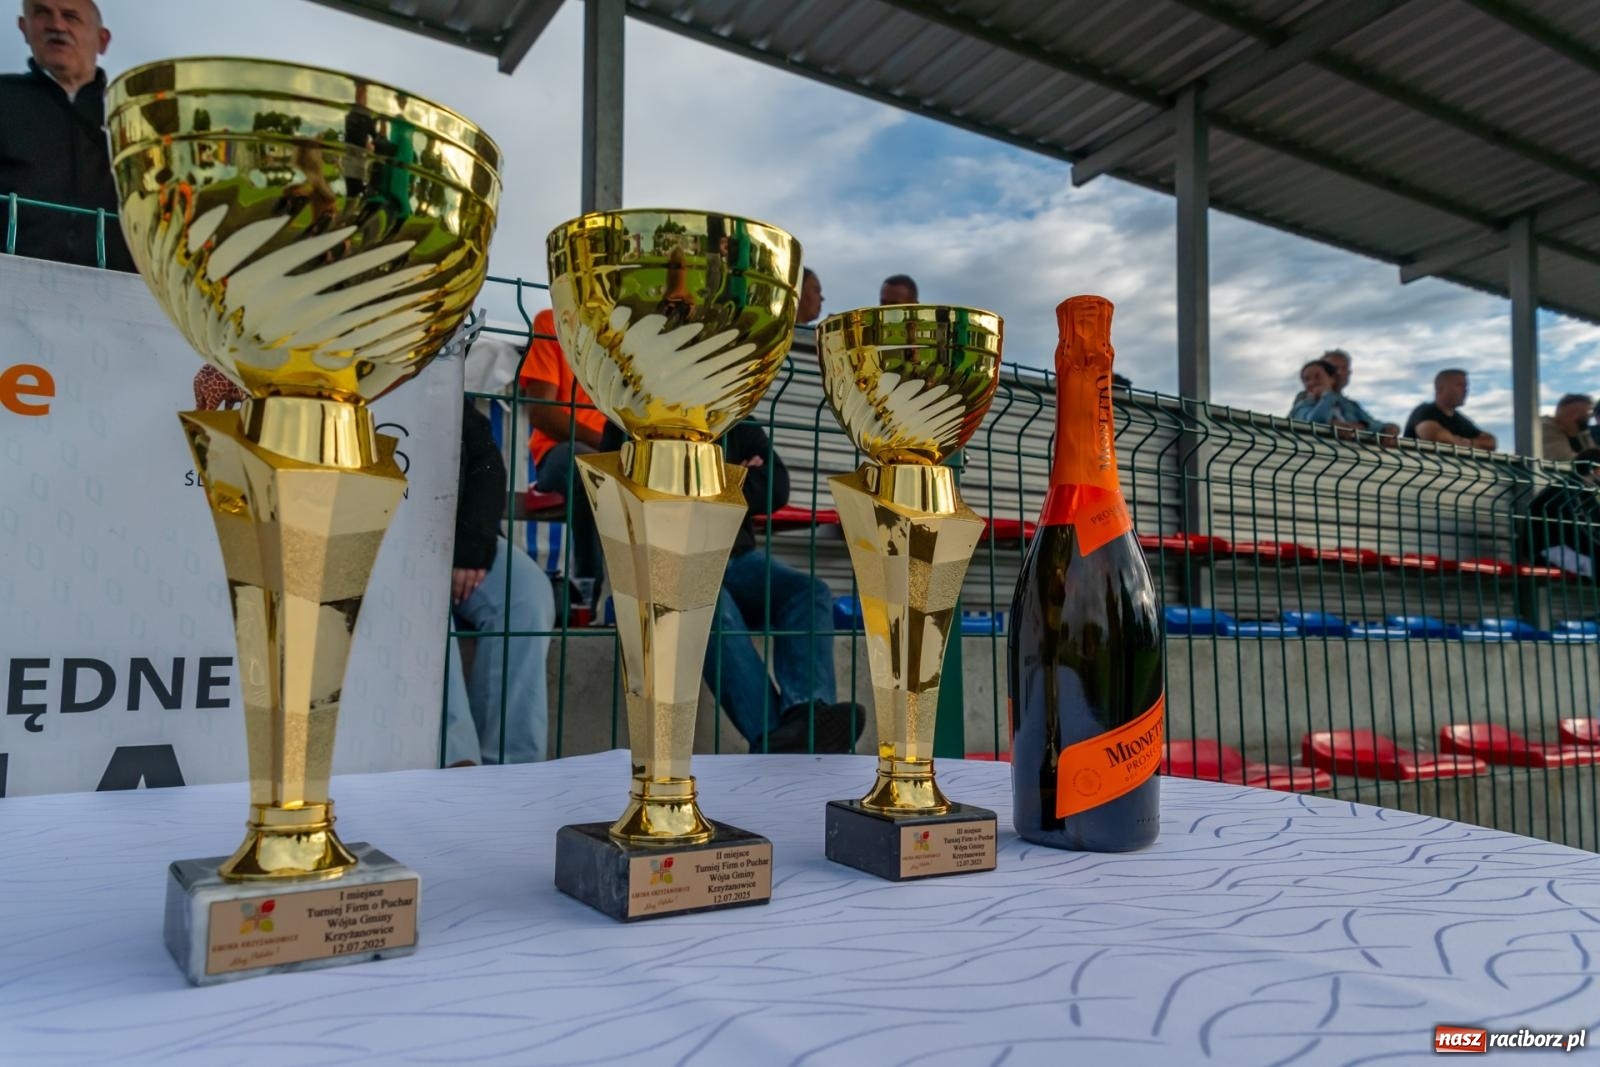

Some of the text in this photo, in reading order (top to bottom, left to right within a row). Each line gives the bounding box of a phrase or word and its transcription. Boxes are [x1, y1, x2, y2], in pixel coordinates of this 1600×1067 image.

[695, 864, 720, 873] Turniej
[722, 861, 738, 870] Firm
[746, 858, 769, 867] Puchar
[709, 871, 755, 883] Wójta Gminy
[347, 889, 384, 900] miejsce
[307, 906, 342, 918] Turniej
[346, 903, 369, 913] Firm
[381, 897, 413, 909] Puchar
[327, 913, 393, 930] Wójta Gminy
[324, 926, 394, 943] Krzyżanowice
[332, 938, 386, 955] 12.07.2025
